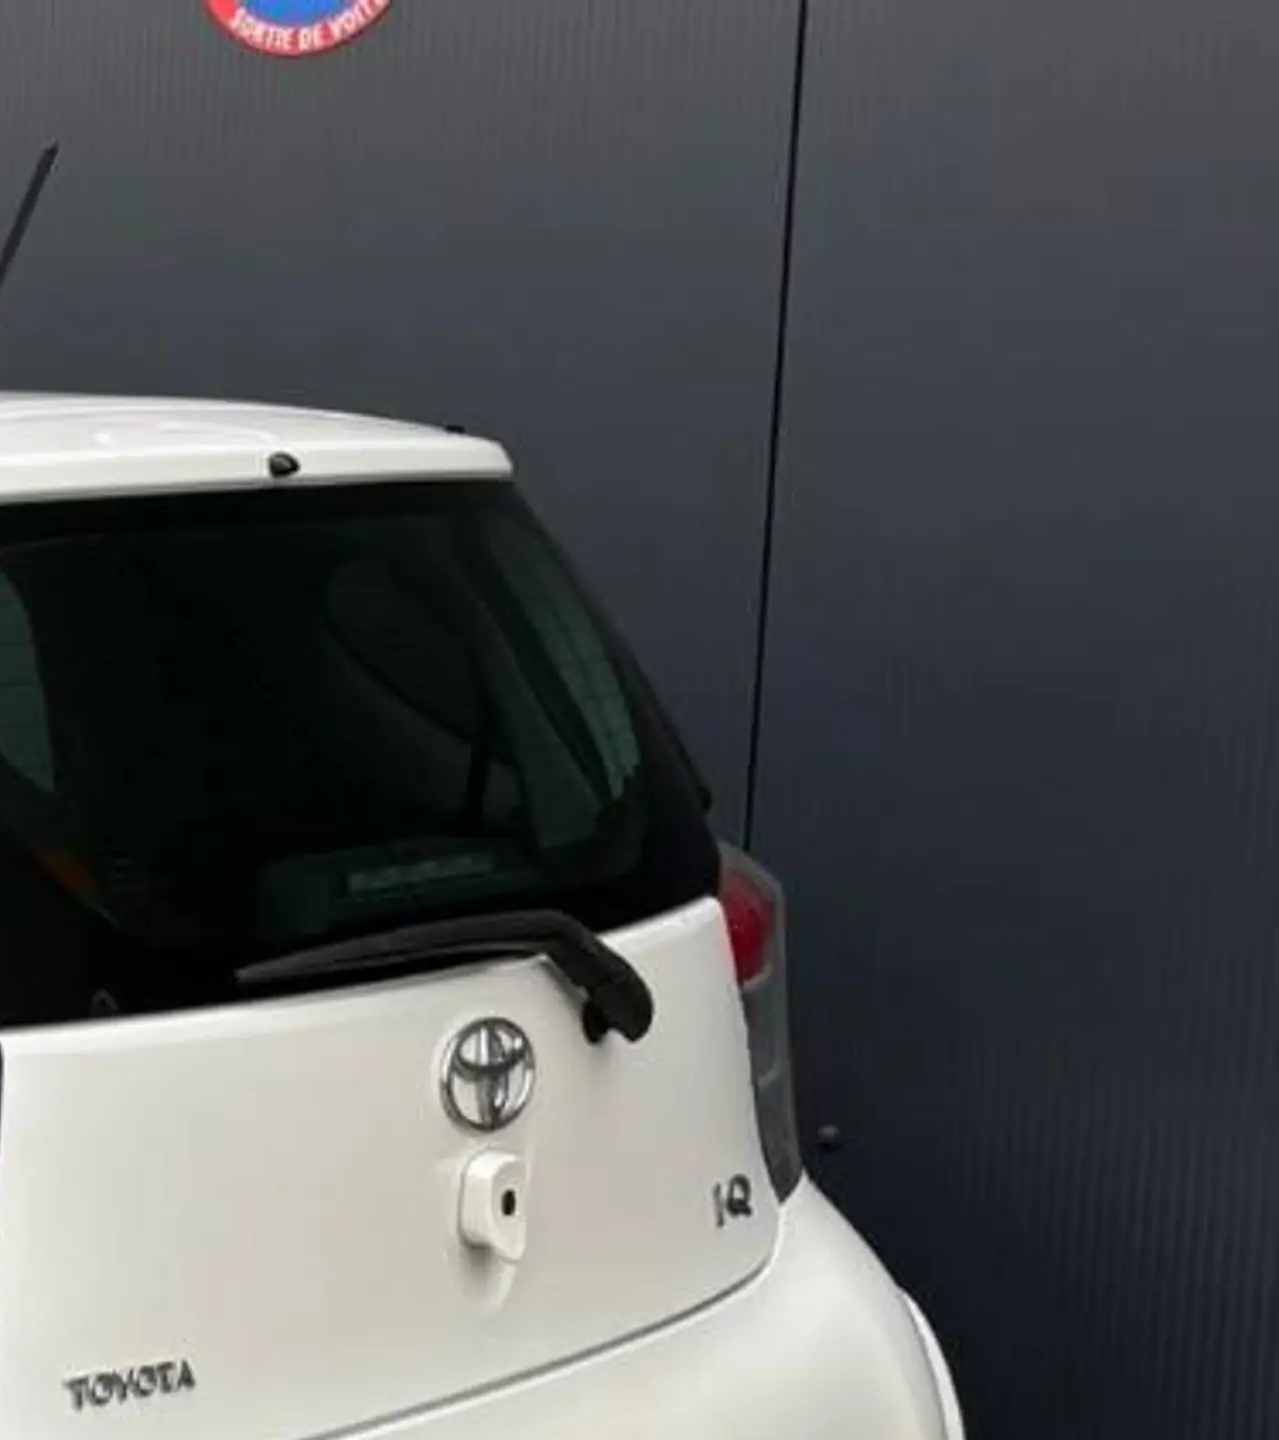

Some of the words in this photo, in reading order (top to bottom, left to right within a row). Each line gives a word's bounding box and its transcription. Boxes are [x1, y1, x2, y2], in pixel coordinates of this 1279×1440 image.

[229, 6, 294, 50] SORTIE
[299, 25, 325, 49] DE
[326, 0, 387, 42] VOIT
[62, 1359, 196, 1414] TOYOTA
